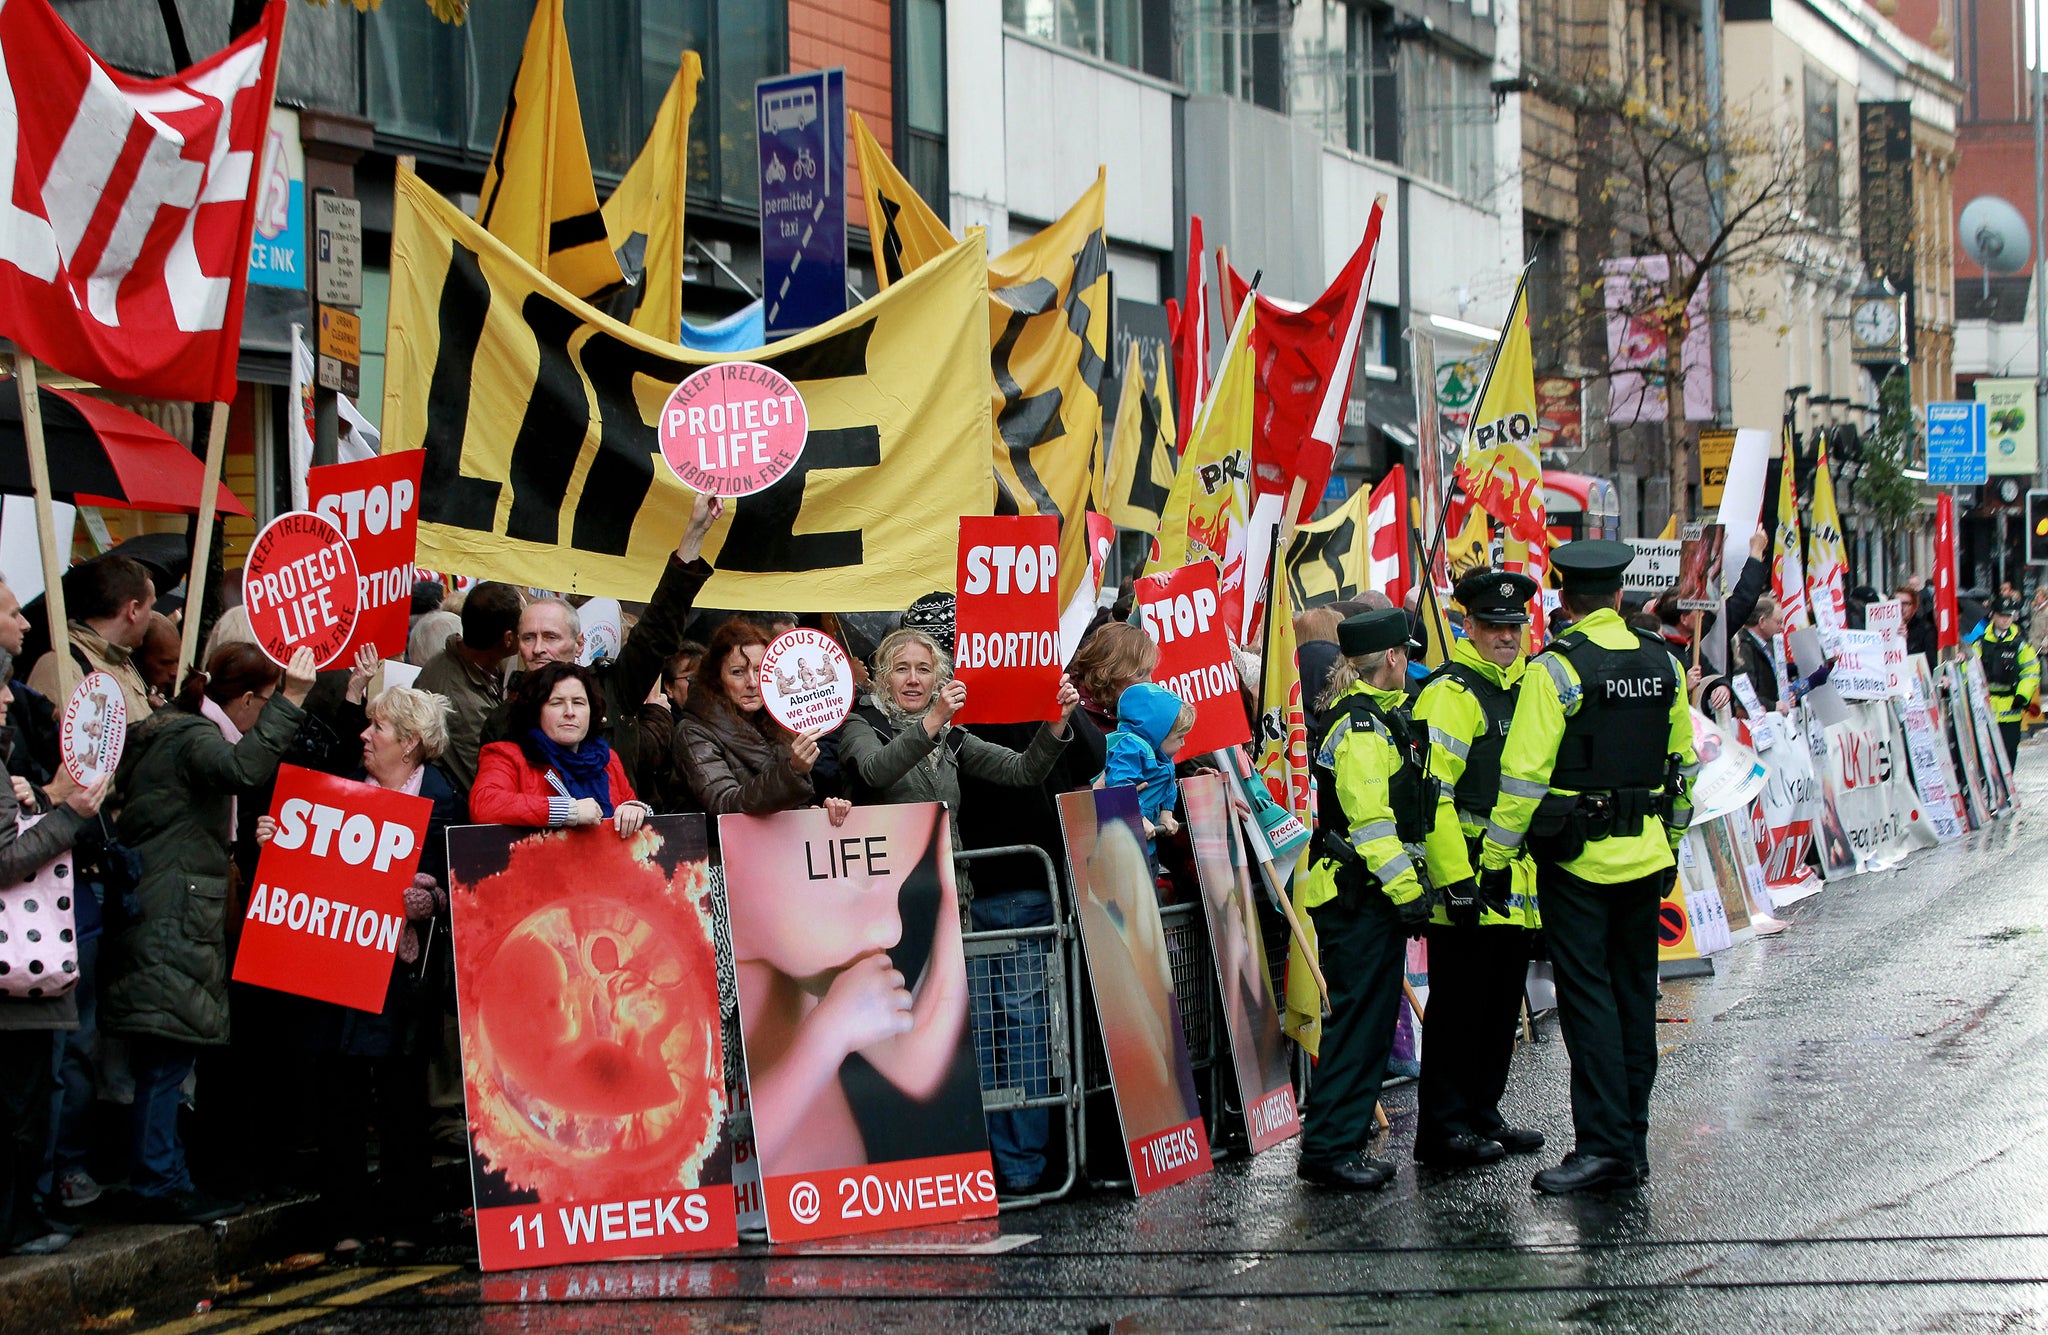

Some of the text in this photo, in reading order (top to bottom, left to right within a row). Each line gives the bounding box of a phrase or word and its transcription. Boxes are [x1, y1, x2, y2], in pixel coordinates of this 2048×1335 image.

[765, 190, 812, 217] permitted
[780, 218, 799, 238] taxi
[270, 246, 296, 273] INK
[418, 238, 881, 574] LIFE
[674, 366, 789, 406] KEEP IRELAND
[668, 395, 797, 438] PROTECT
[676, 449, 795, 493] ABORTION-FREE
[697, 430, 772, 471] LIFE
[316, 479, 415, 541] STOP
[250, 517, 335, 574] KEEP IRELAND
[964, 544, 1058, 595] STOP
[1648, 559, 1660, 570] is
[248, 541, 347, 614] PROTECT
[277, 586, 339, 646] LIFE
[1141, 588, 1217, 646] STOP
[761, 632, 845, 683] PRECIOUS LIFE
[955, 631, 1063, 669] ABORTION
[786, 696, 844, 719] we can live
[790, 685, 835, 706] Abortion?
[1606, 677, 1663, 699] POLICE
[63, 675, 101, 780] PRECIOUS LIFE
[99, 703, 113, 764] Abortion?
[792, 707, 845, 730] without it
[110, 720, 123, 773] without
[273, 798, 416, 873] STOP
[805, 836, 891, 880] LIFE
[247, 883, 403, 954] ABORTION
[1252, 1090, 1294, 1138] 20 WEEKS
[1140, 1126, 1199, 1178] 7 WEEKS
[508, 1194, 710, 1251] 11 WEEKS
[788, 1181, 822, 1225] @
